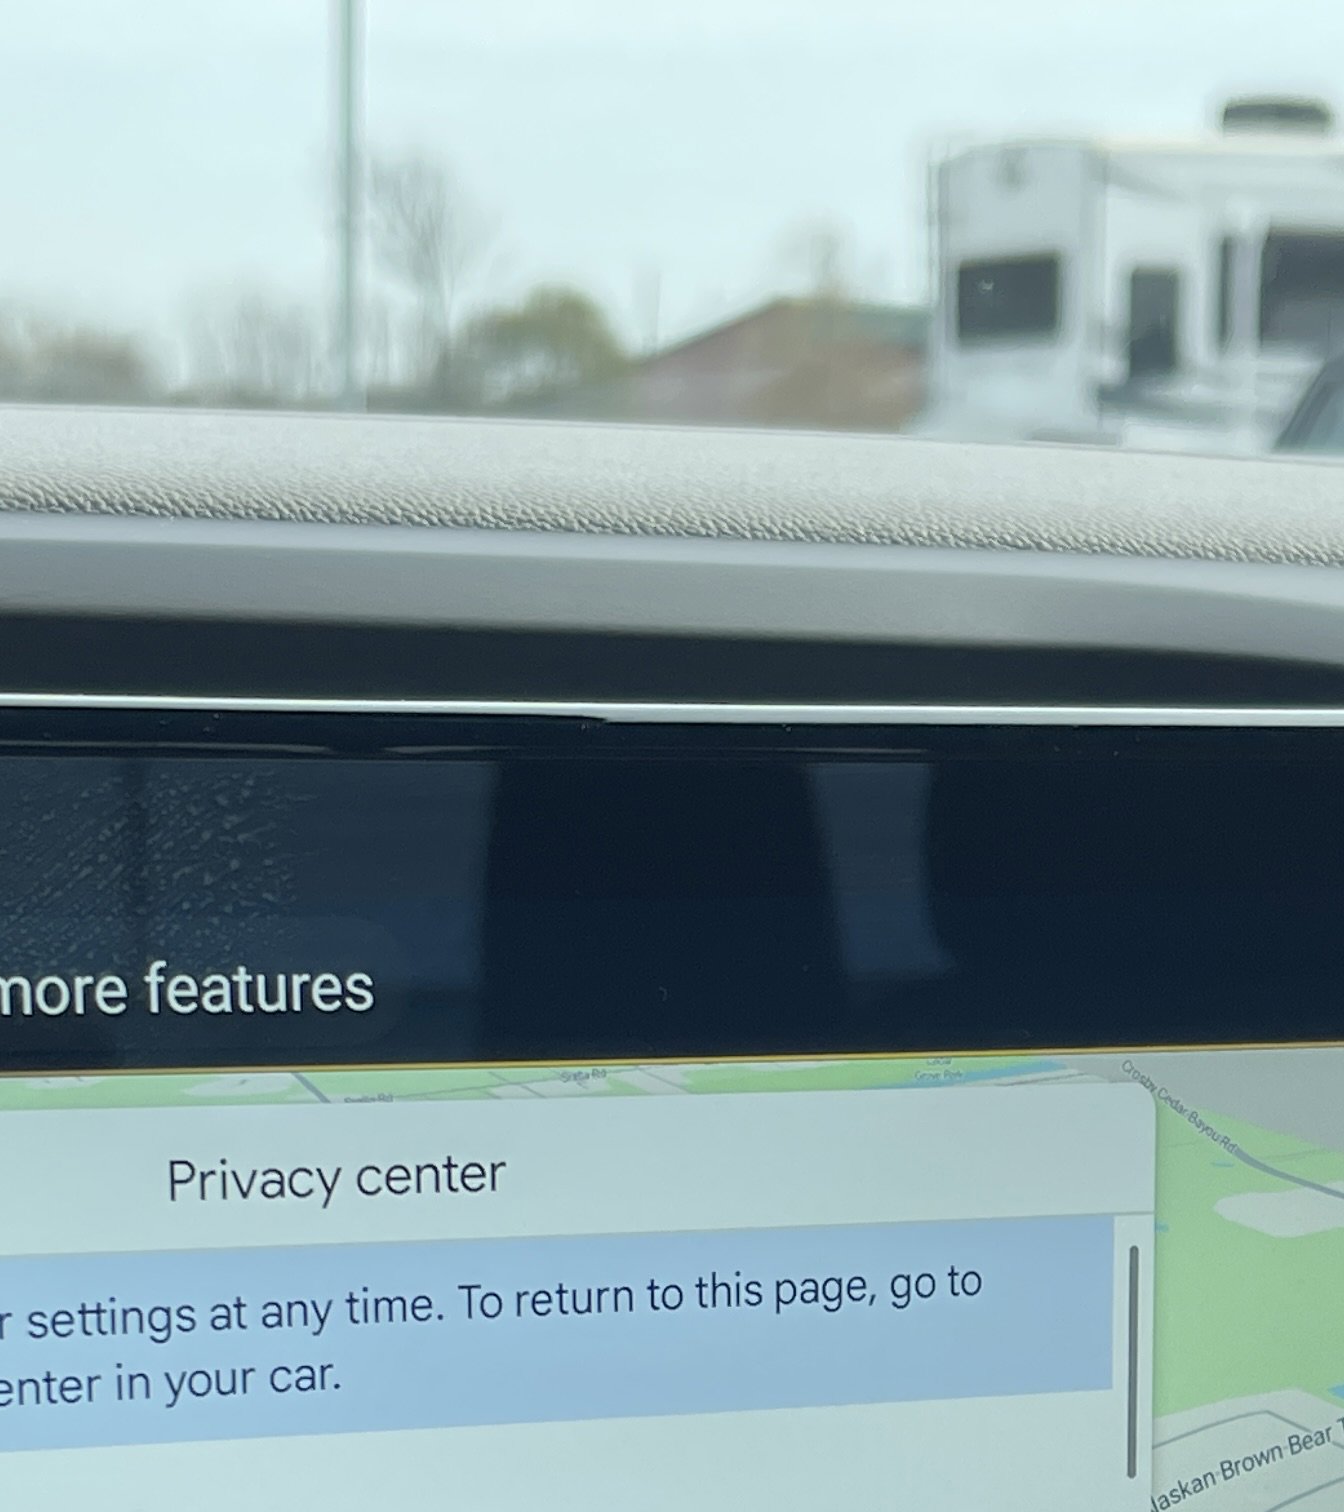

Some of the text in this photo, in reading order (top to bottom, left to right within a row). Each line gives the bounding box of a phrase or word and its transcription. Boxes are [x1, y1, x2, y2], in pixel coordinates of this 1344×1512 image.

[145, 961, 374, 1014] features
[1188, 1111, 1220, 1142] Bayou
[1220, 1135, 1238, 1153] Rd
[167, 1155, 506, 1209] Privacy center
[27, 1297, 196, 1343] settings
[210, 1295, 248, 1332] at
[260, 1294, 333, 1337] any
[345, 1285, 445, 1326] time.
[458, 1282, 504, 1320] To
[515, 1278, 635, 1317] return
[647, 1276, 684, 1312] to
[695, 1270, 763, 1309] this
[775, 1272, 877, 1315] page,
[890, 1268, 937, 1309] go
[948, 1264, 983, 1297] to
[115, 1362, 151, 1401] in
[165, 1364, 256, 1408] your
[268, 1357, 342, 1394] car.
[1219, 1443, 1284, 1482] Brown
[1287, 1426, 1333, 1456] Bear
